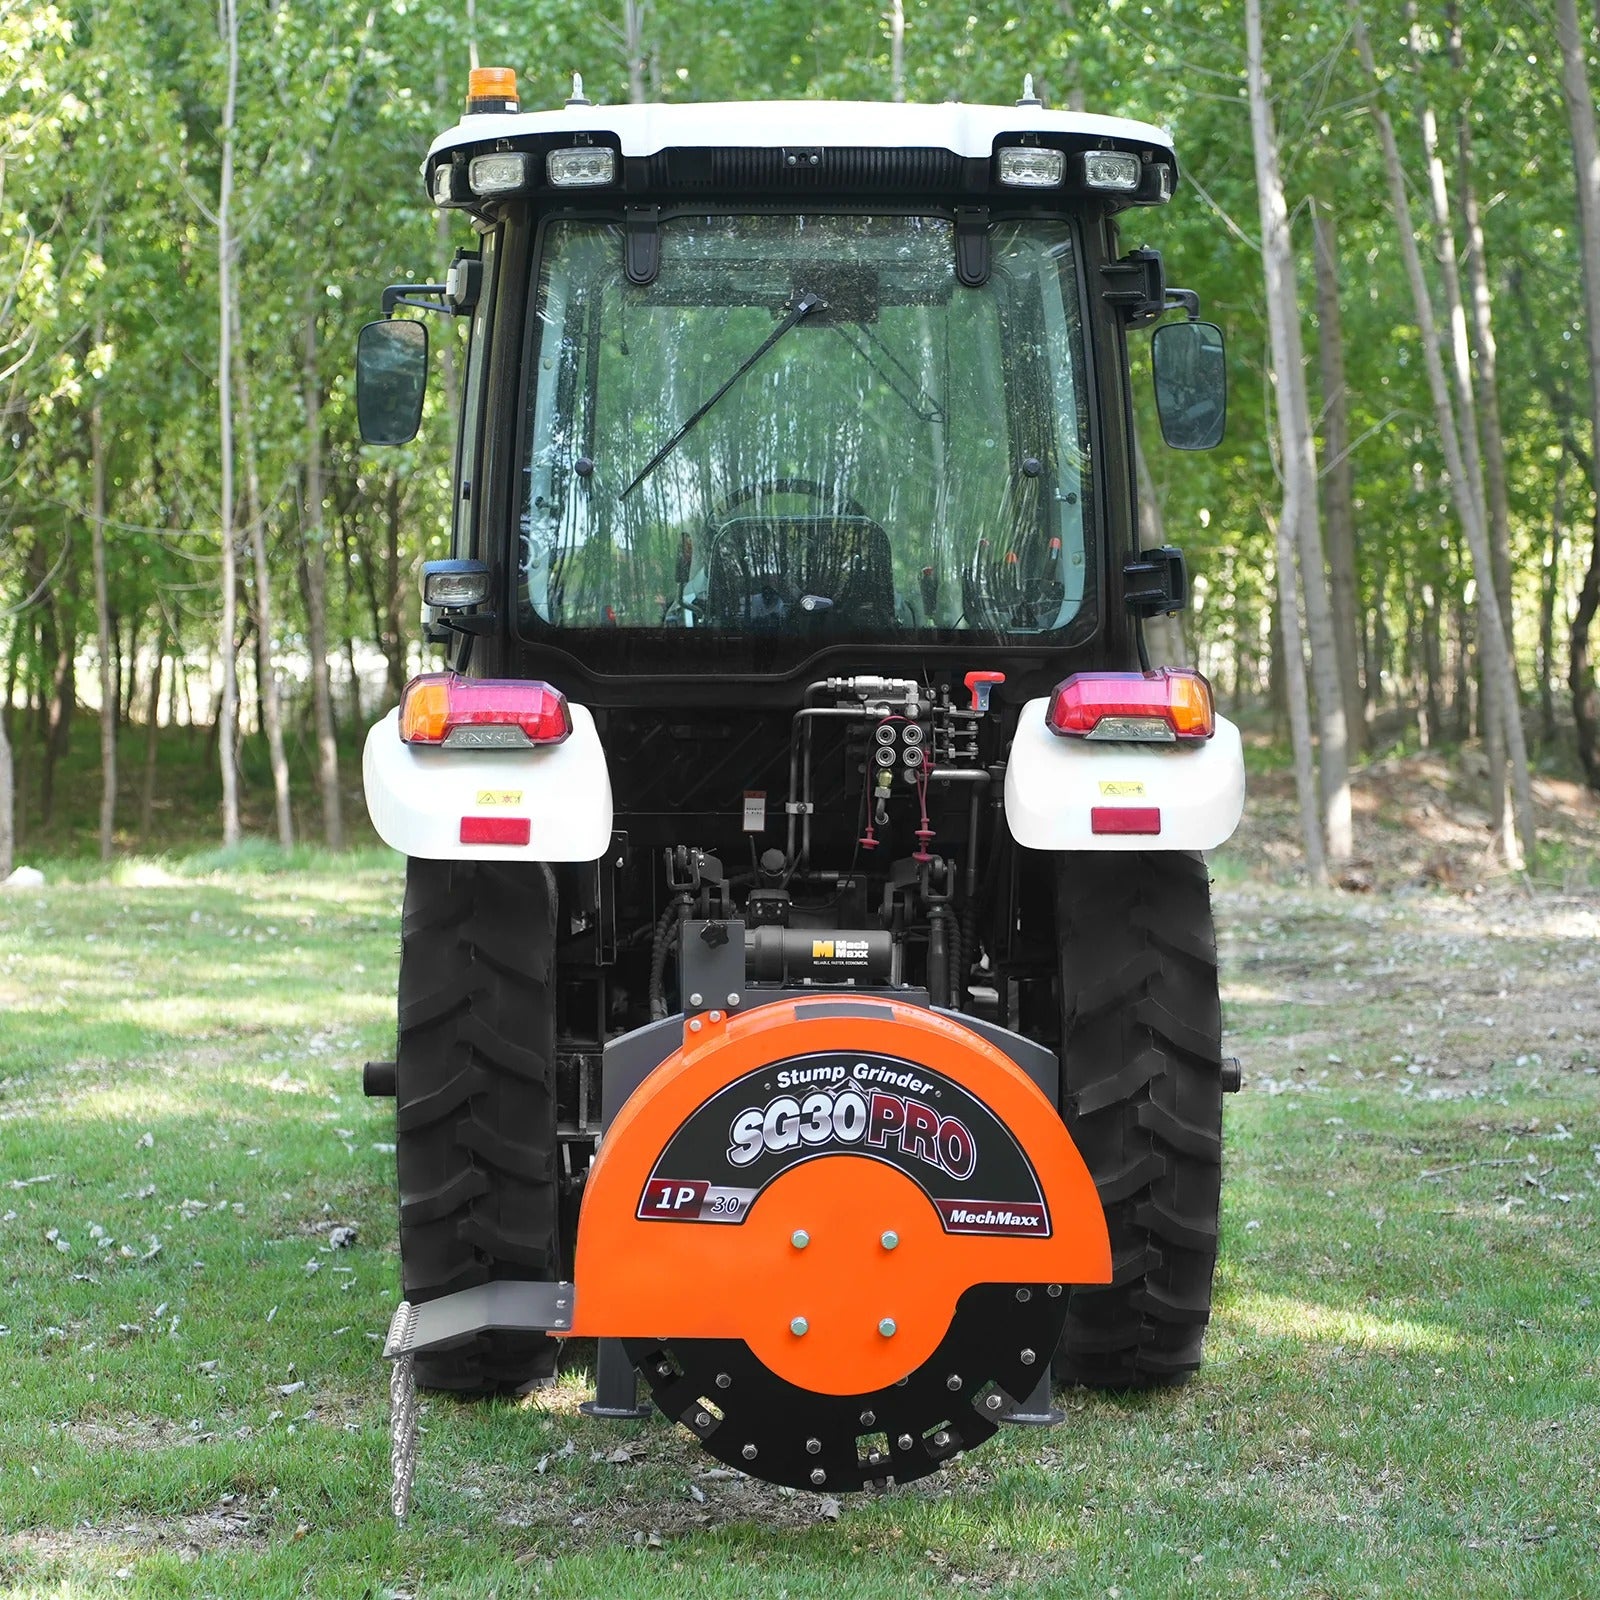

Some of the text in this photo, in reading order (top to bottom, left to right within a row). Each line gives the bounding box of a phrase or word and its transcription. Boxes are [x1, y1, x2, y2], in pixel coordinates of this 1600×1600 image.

[835, 949, 869, 958] Maxx
[777, 1063, 935, 1095] Stump Grinder
[655, 1187, 739, 1214] 1P 30
[949, 1209, 1040, 1227] MechMaxx
